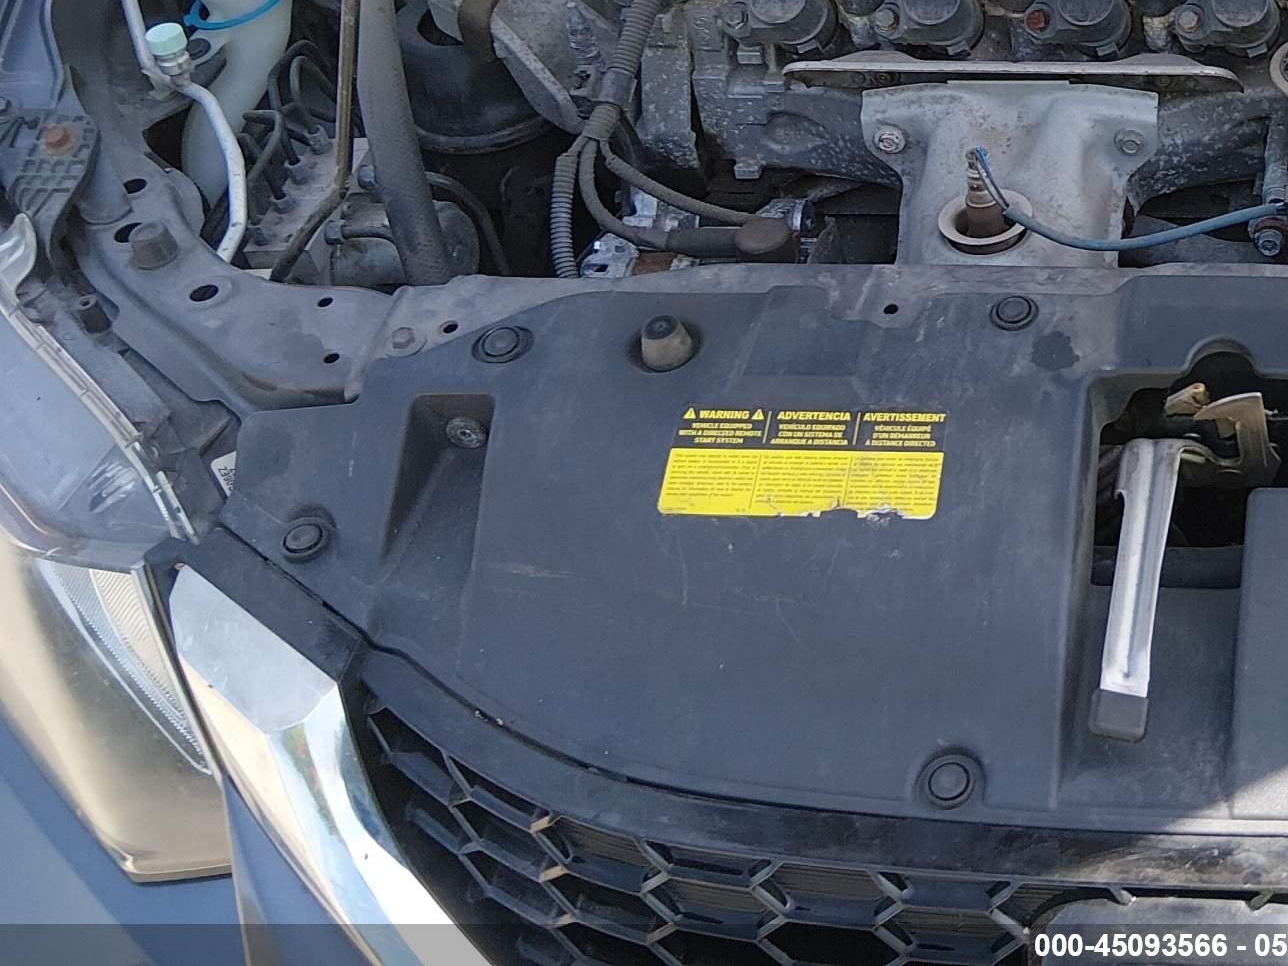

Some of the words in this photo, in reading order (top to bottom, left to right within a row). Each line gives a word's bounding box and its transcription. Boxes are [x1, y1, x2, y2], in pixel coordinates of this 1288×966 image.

[699, 410, 750, 420] WARNING
[777, 411, 851, 422] ADVERTENCIA
[863, 412, 947, 423] AVERTISSEMENT
